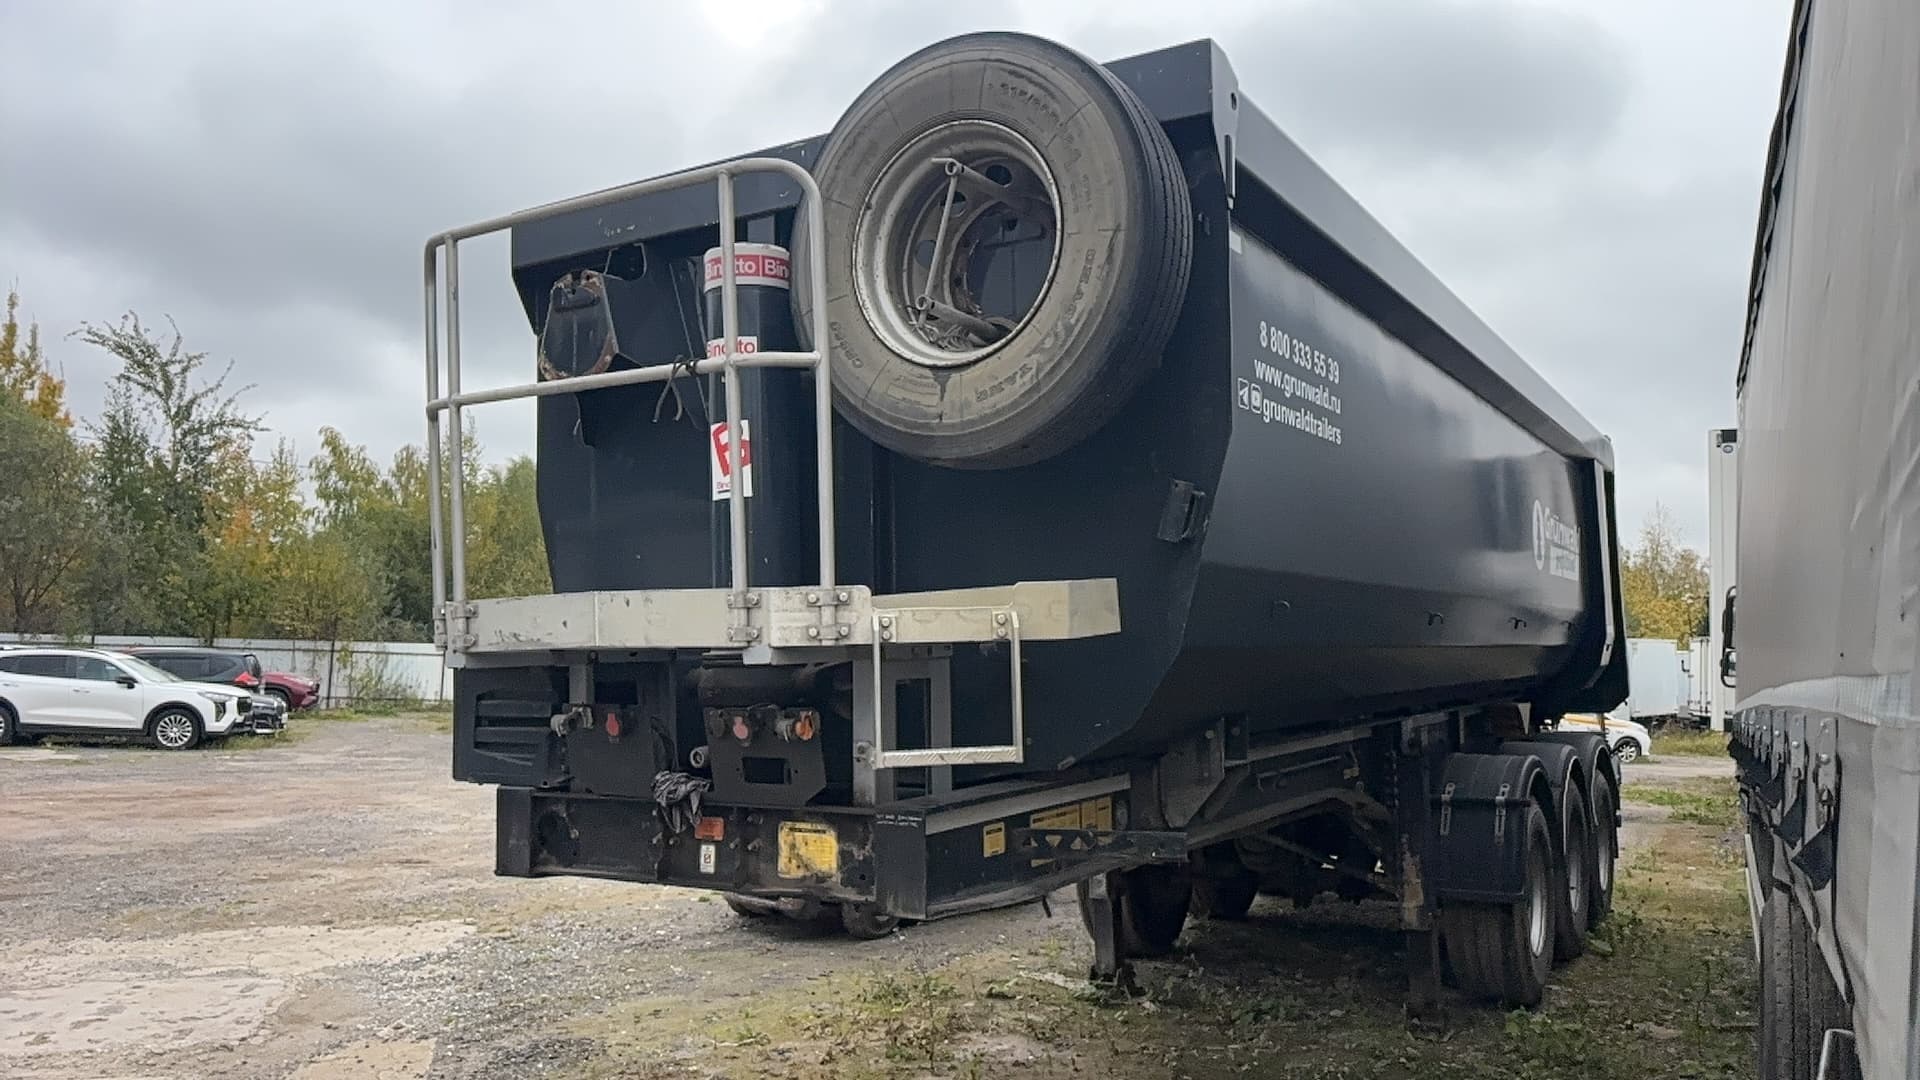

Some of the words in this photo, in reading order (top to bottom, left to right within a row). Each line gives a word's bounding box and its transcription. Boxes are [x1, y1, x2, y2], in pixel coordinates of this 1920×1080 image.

[704, 258, 757, 280] Binto
[1260, 320, 1268, 348] 8
[1270, 326, 1290, 360] 800
[1292, 338, 1312, 371] 333
[1314, 350, 1327, 378] 55
[1328, 357, 1340, 385] 39
[1254, 359, 1341, 415] www.grunwald.ru
[1263, 398, 1342, 445] grunwaldtrailers
